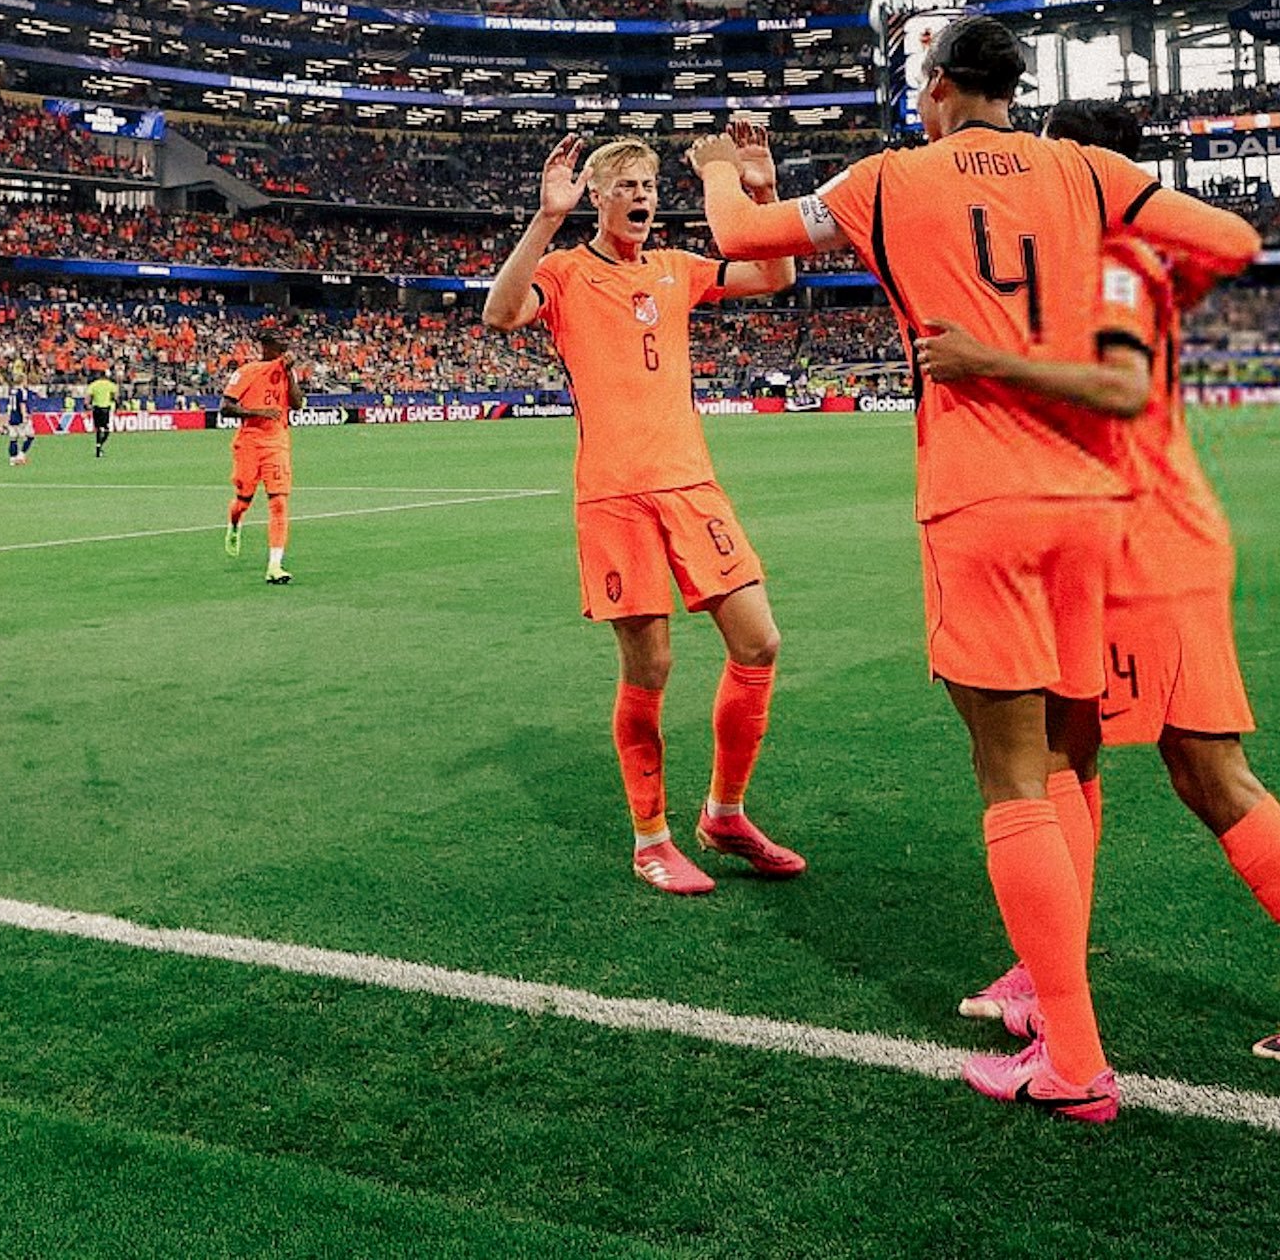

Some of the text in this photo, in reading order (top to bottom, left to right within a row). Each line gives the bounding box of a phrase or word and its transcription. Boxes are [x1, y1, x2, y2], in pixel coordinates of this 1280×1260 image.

[485, 16, 511, 31] FIFA
[510, 18, 552, 32] WORLD
[552, 19, 576, 32] CUP
[757, 17, 807, 32] DALLAS
[954, 151, 1031, 176] VIRGIL
[968, 203, 1042, 344] 4
[643, 332, 660, 372] 6
[265, 390, 280, 406] 24
[859, 394, 916, 412] Globan
[289, 408, 341, 426] Globant
[365, 406, 405, 423] SAVVY
[407, 406, 445, 421] GAMES
[447, 405, 480, 420] GROUP
[706, 518, 734, 555] 6
